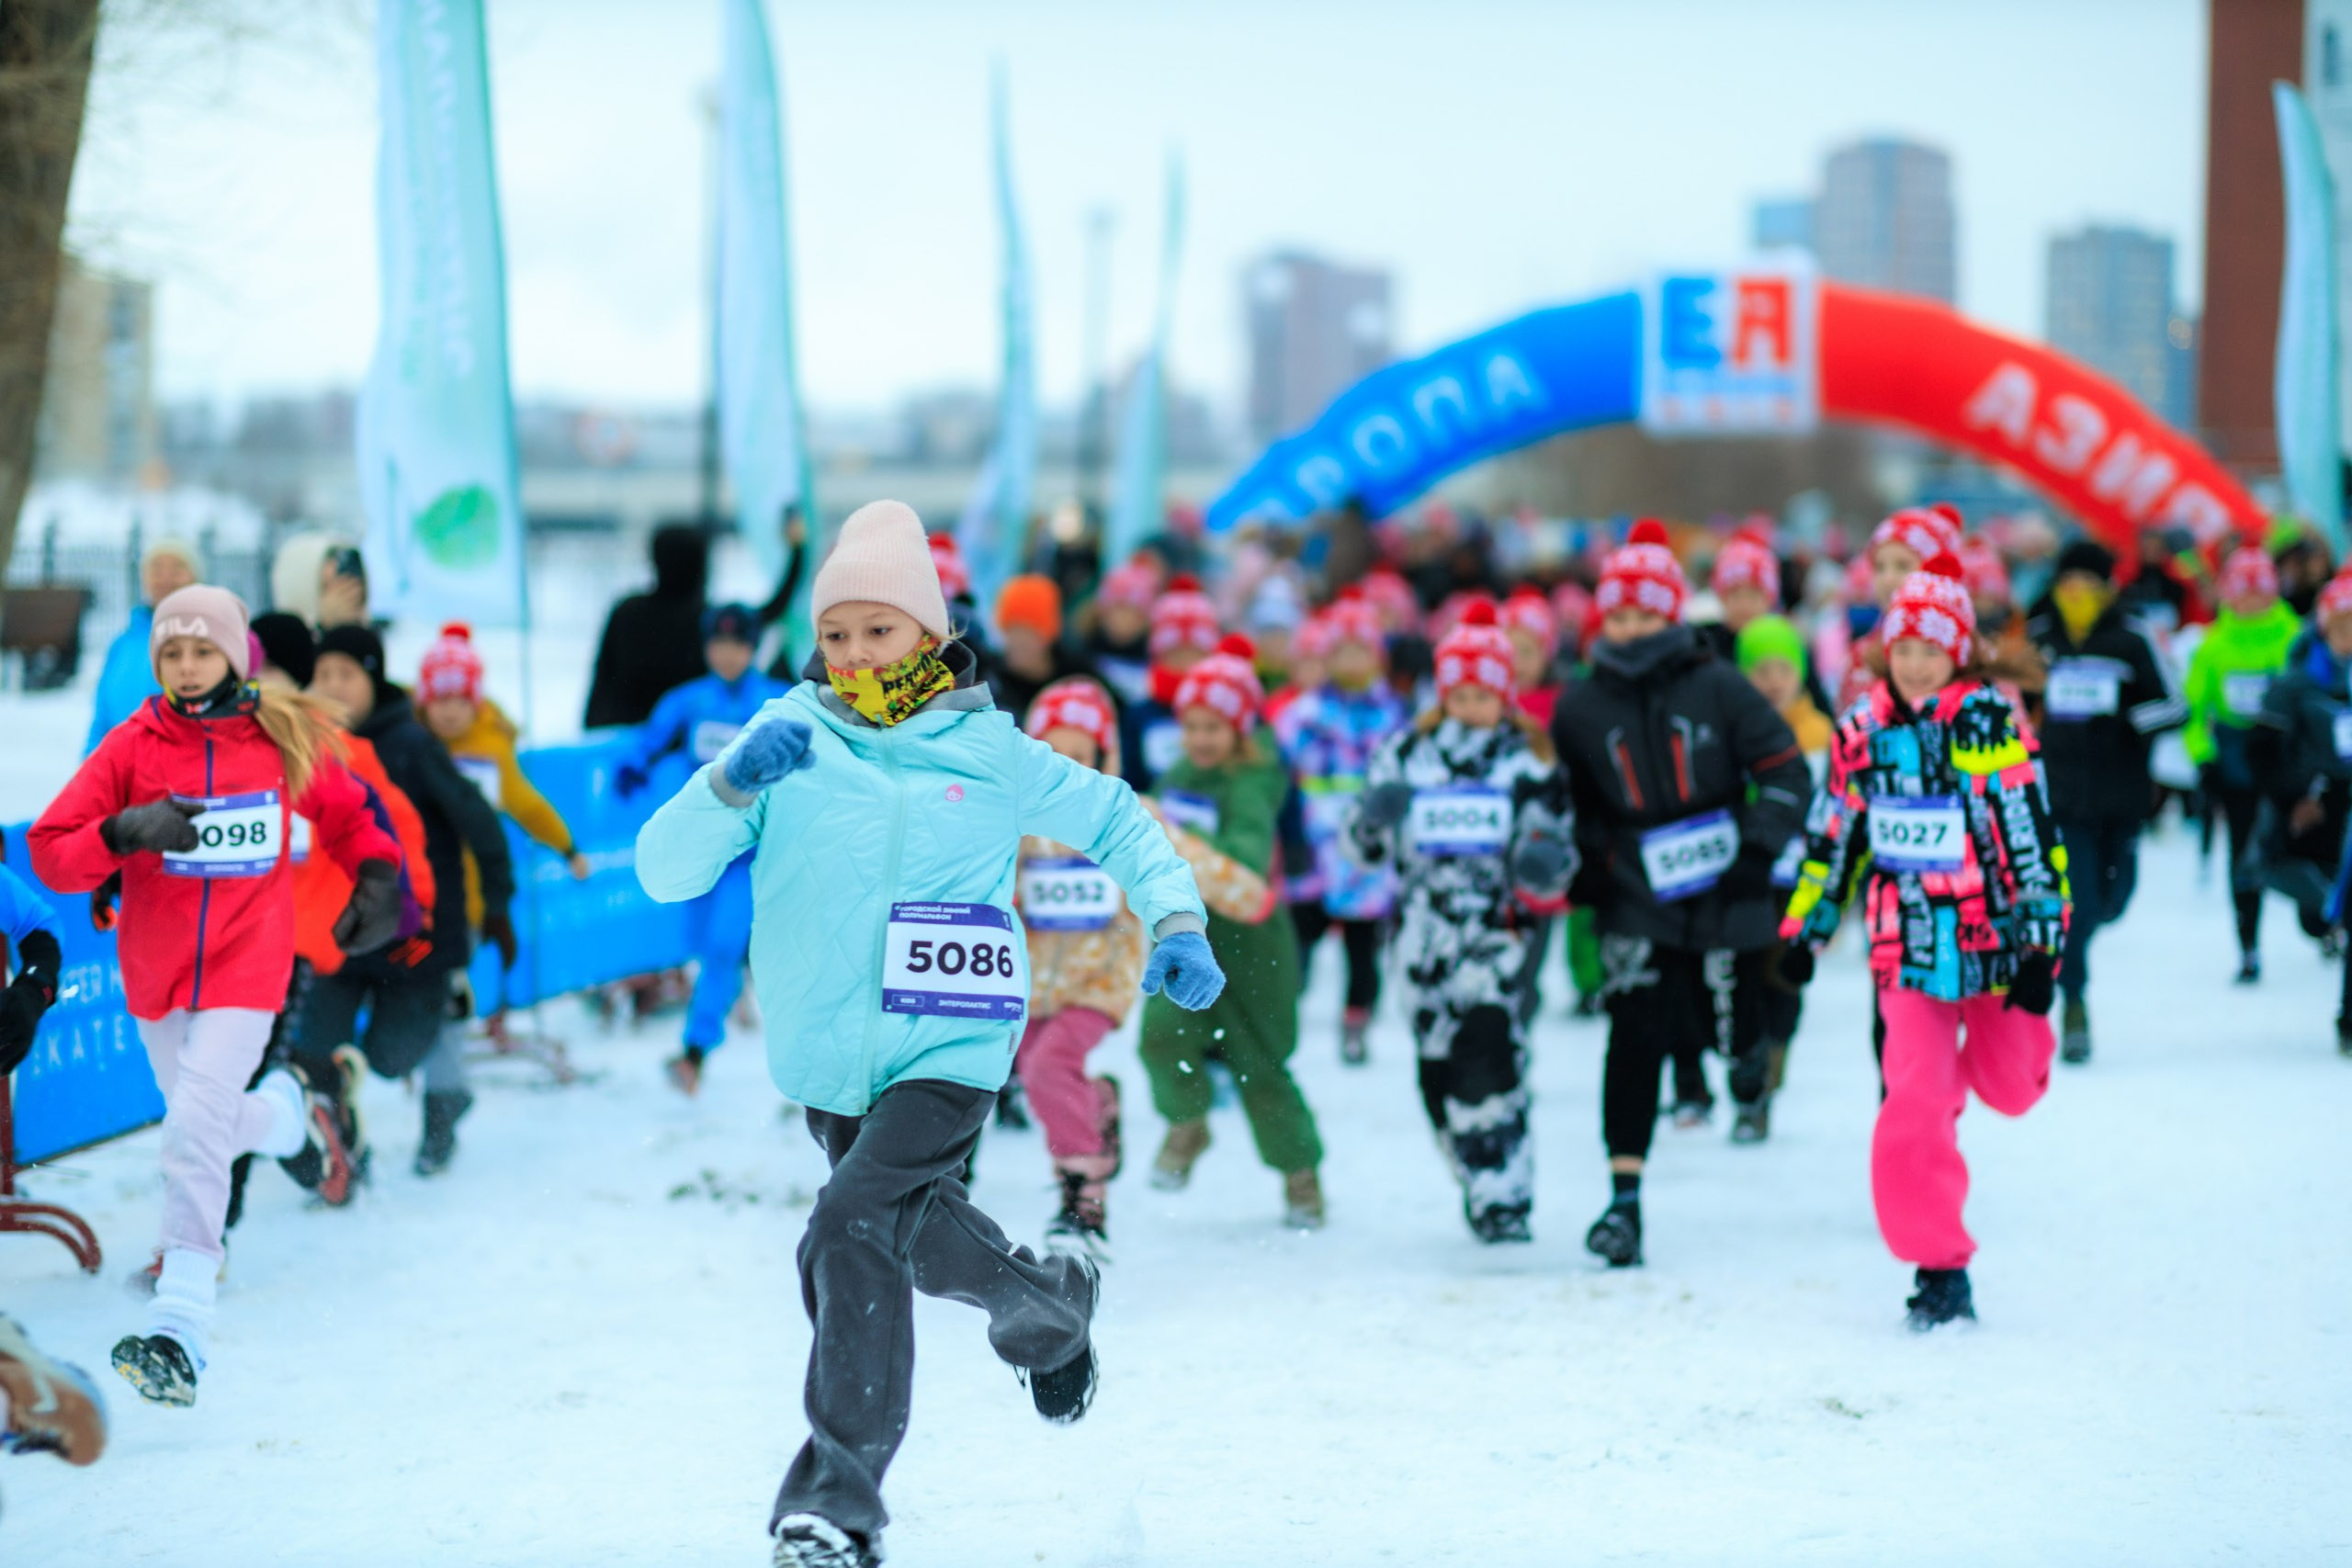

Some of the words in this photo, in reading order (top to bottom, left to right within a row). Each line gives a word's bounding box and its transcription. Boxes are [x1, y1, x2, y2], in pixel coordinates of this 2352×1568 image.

[201, 820, 266, 847] 098
[1878, 819, 1948, 846] 5027
[1032, 880, 1104, 905] 5052
[905, 940, 1013, 978] 5086
